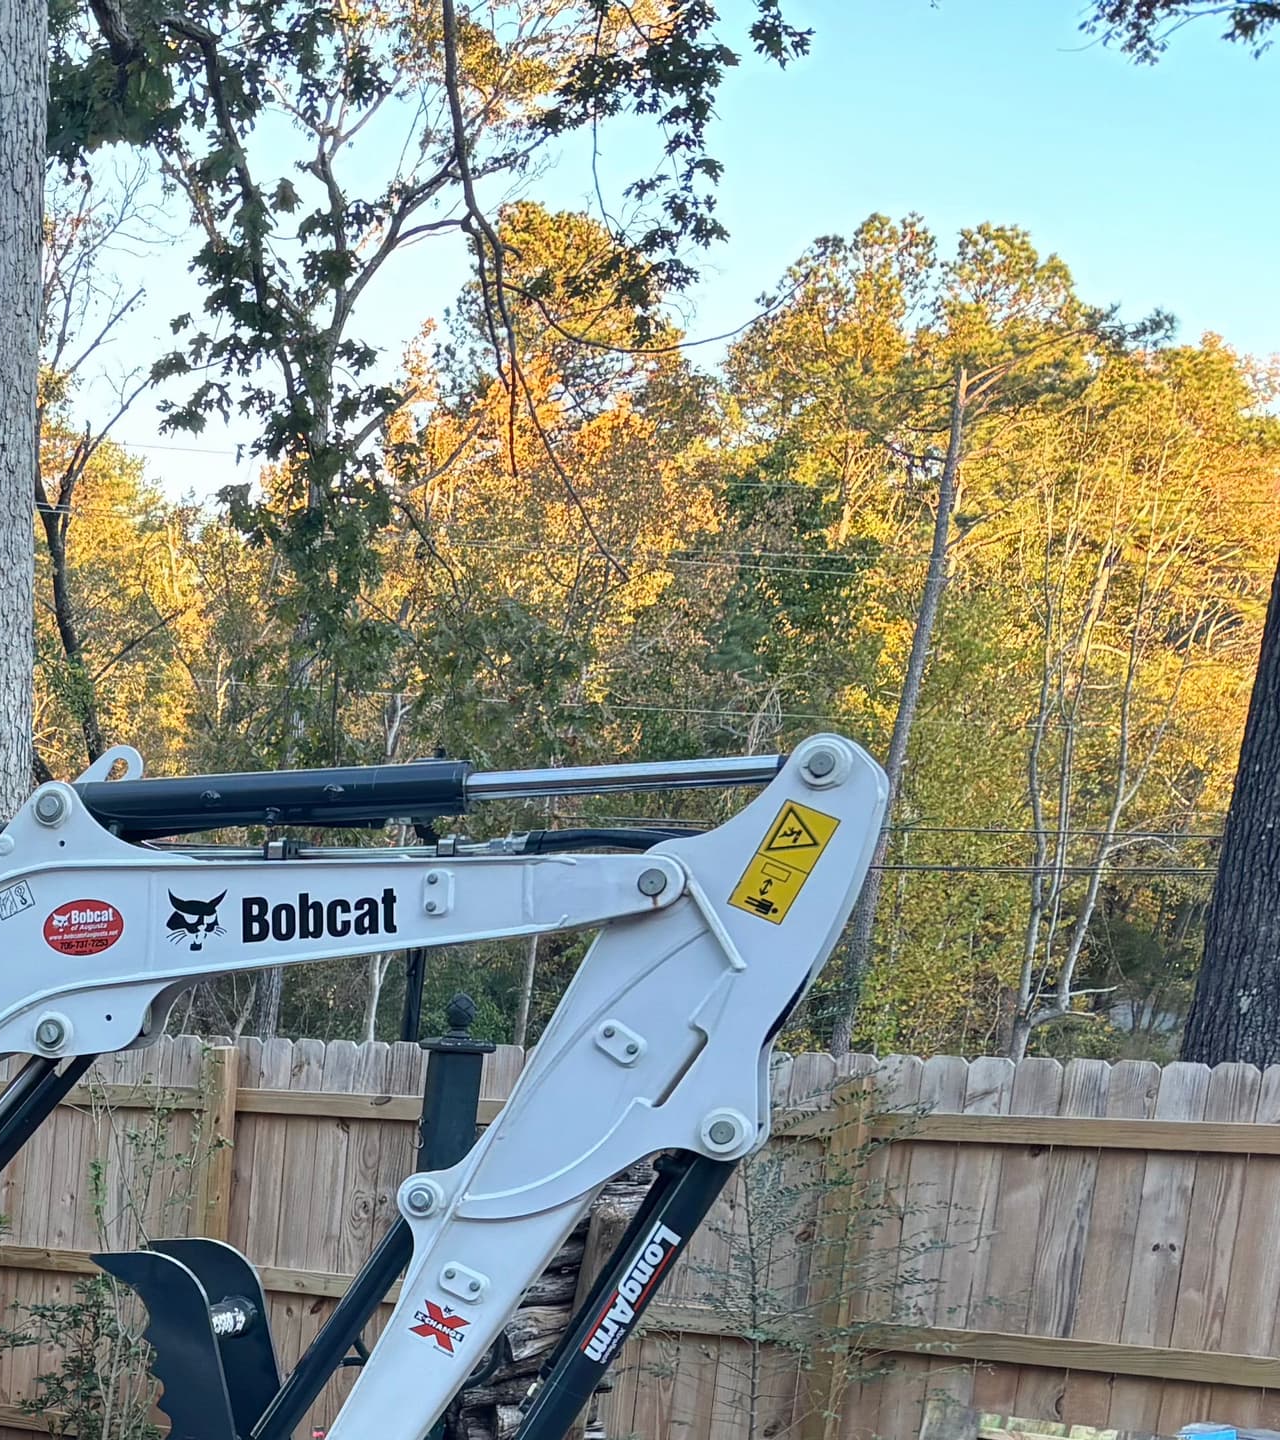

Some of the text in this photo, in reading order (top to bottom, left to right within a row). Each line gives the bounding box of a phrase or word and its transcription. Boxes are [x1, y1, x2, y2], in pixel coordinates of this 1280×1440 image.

[70, 908, 114, 924] Bobcat
[242, 888, 397, 943] Bobcat
[583, 1221, 682, 1362] LongArm
